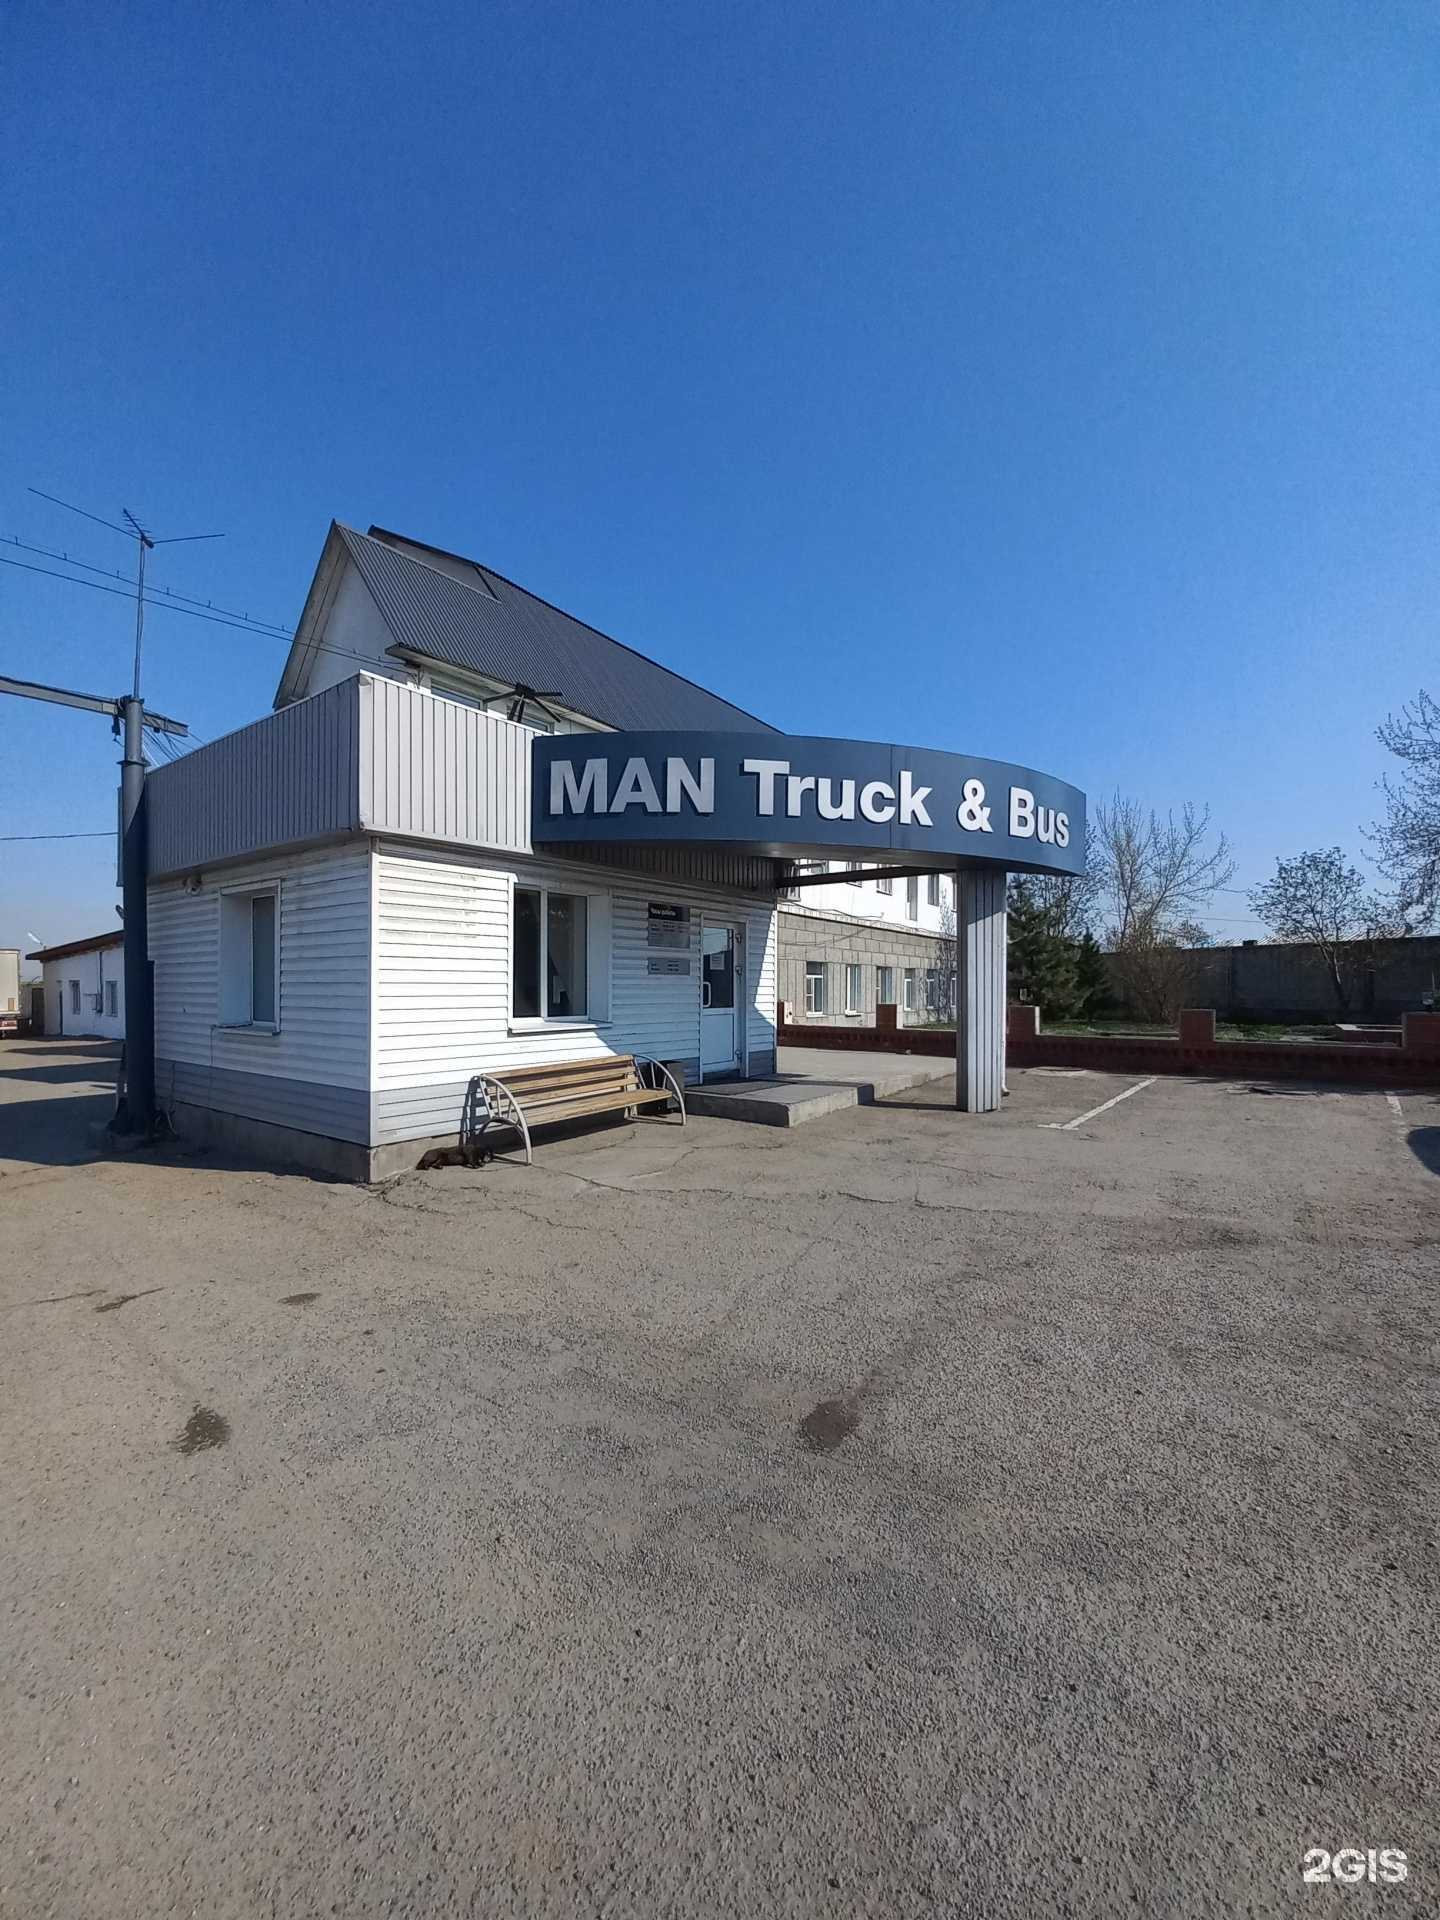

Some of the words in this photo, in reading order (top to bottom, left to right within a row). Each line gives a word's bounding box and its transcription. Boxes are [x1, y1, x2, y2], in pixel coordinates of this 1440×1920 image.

[550, 757, 715, 815] MAN
[743, 758, 933, 827] Truck
[957, 778, 993, 833] &
[1009, 786, 1069, 848] Bus
